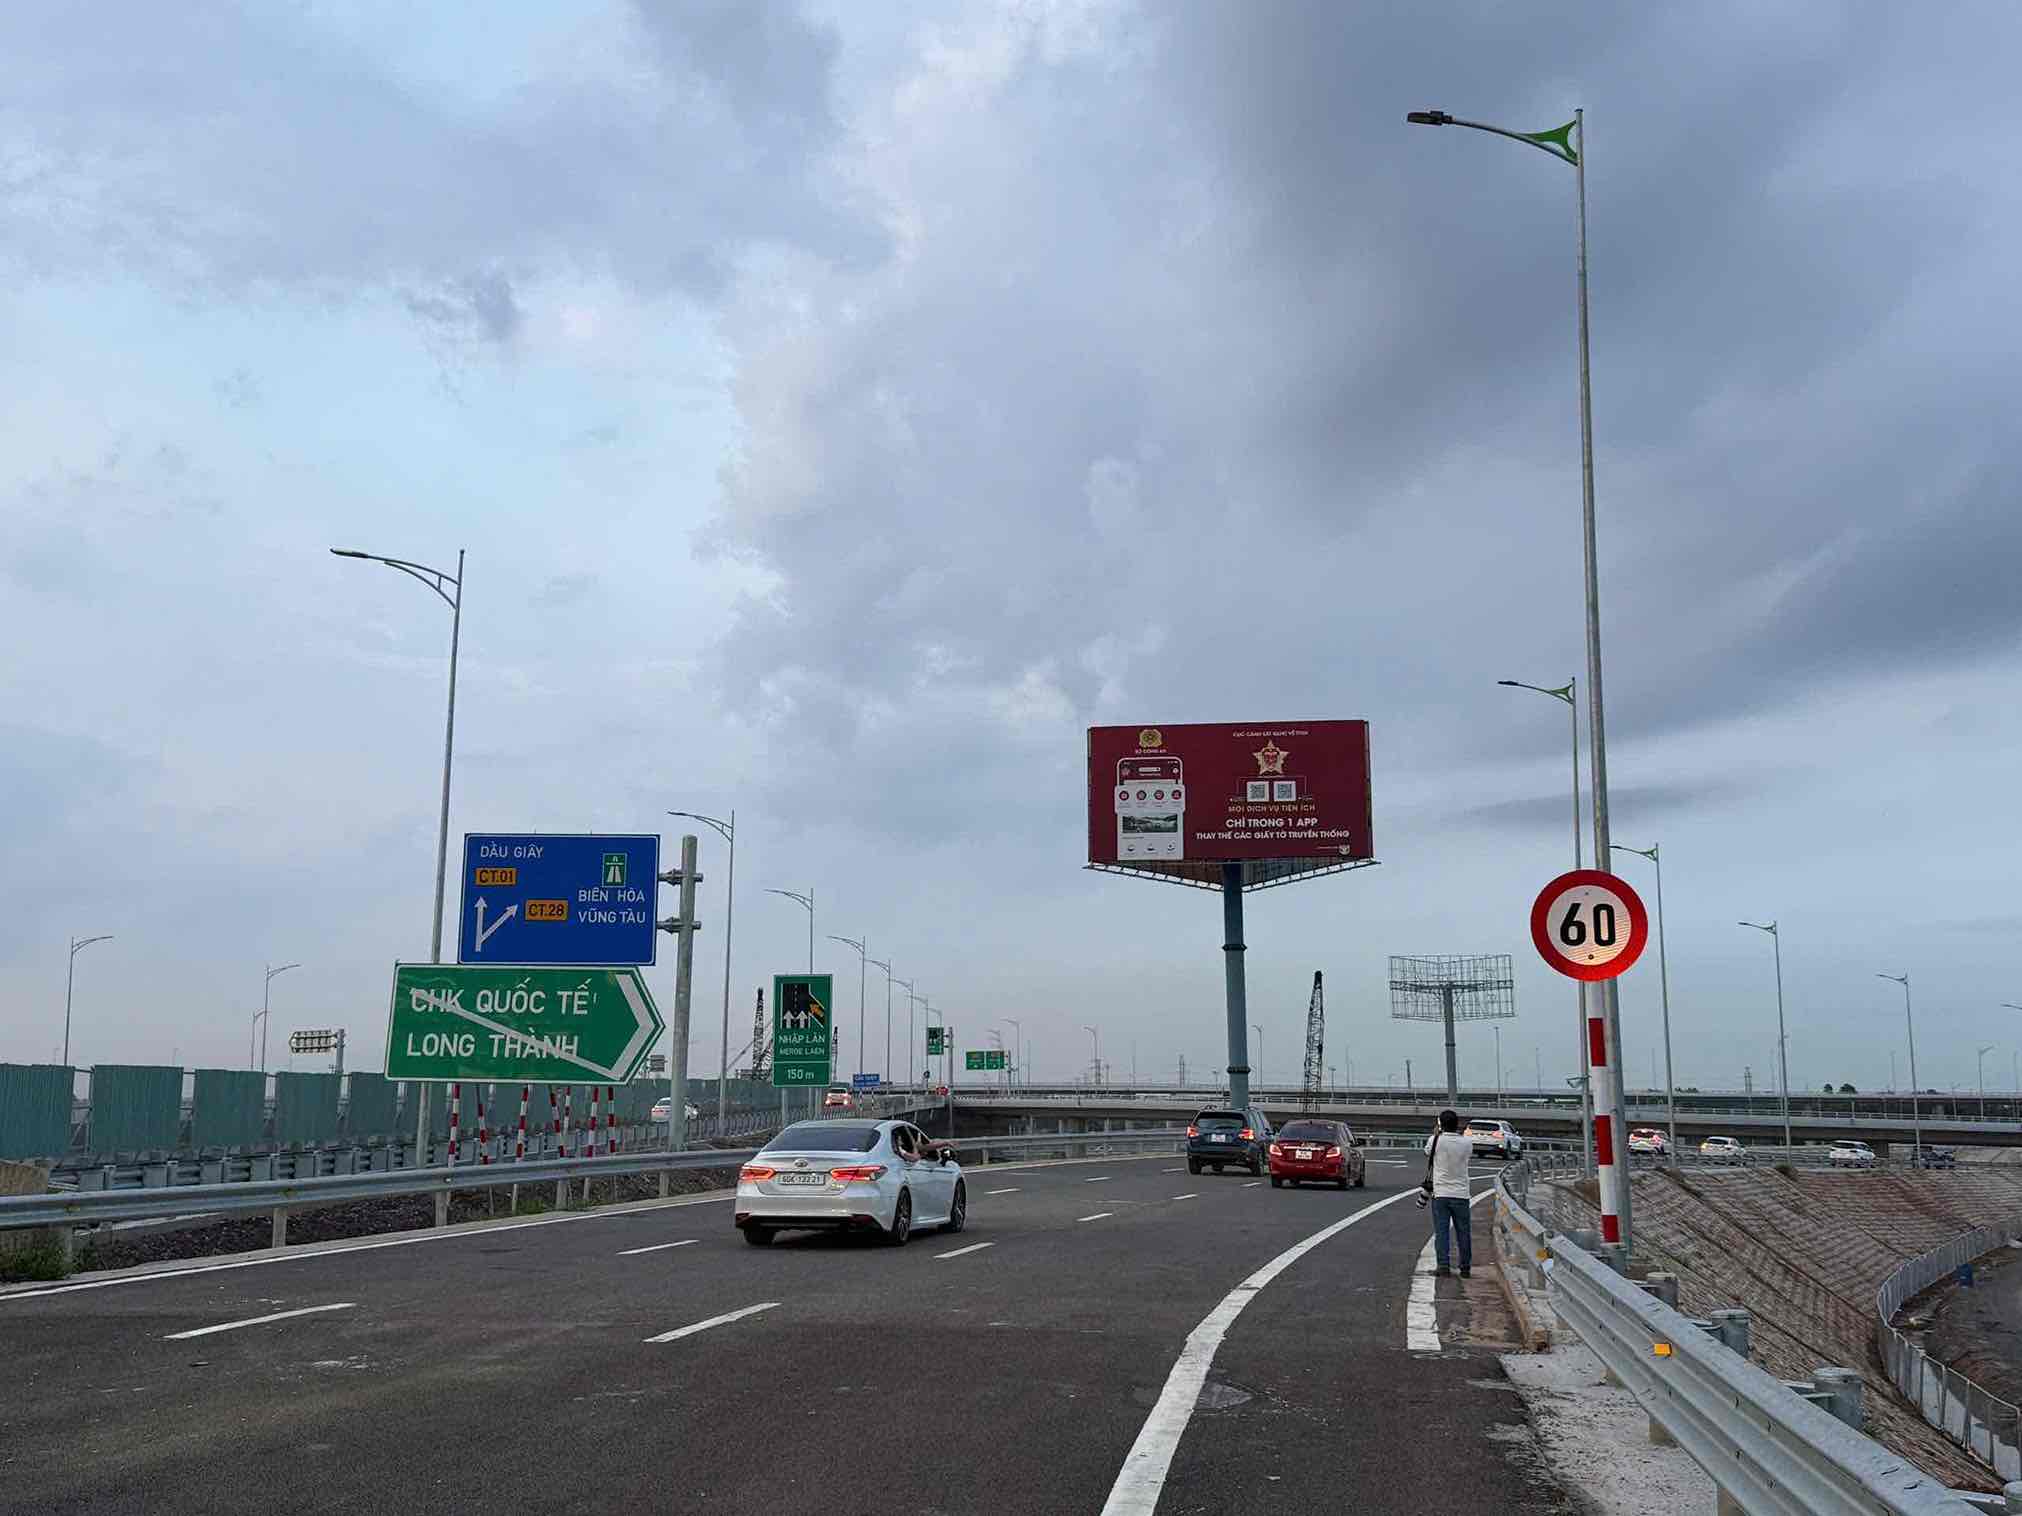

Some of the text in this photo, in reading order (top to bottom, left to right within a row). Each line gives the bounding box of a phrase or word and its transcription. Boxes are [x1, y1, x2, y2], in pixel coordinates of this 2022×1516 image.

[1226, 816, 1319, 828] CHỈ TRONG 1 APP
[1196, 832, 1216, 840] THAY
[1218, 830, 1232, 840] THẾ
[1233, 831, 1252, 840] CÁC
[1320, 828, 1350, 839] THỐNG
[480, 841, 544, 858] DẦU GIÂY
[479, 870, 513, 884] CT.01
[578, 887, 645, 902] BIÊN HÒA
[528, 904, 565, 917] CT.28
[578, 908, 646, 924] VŨNG TÀU
[1560, 902, 1616, 947] 60
[410, 977, 593, 1016] CHK QUỐC TẾ
[407, 1027, 578, 1059] LONG THÀNH
[787, 1069, 804, 1080] 150
